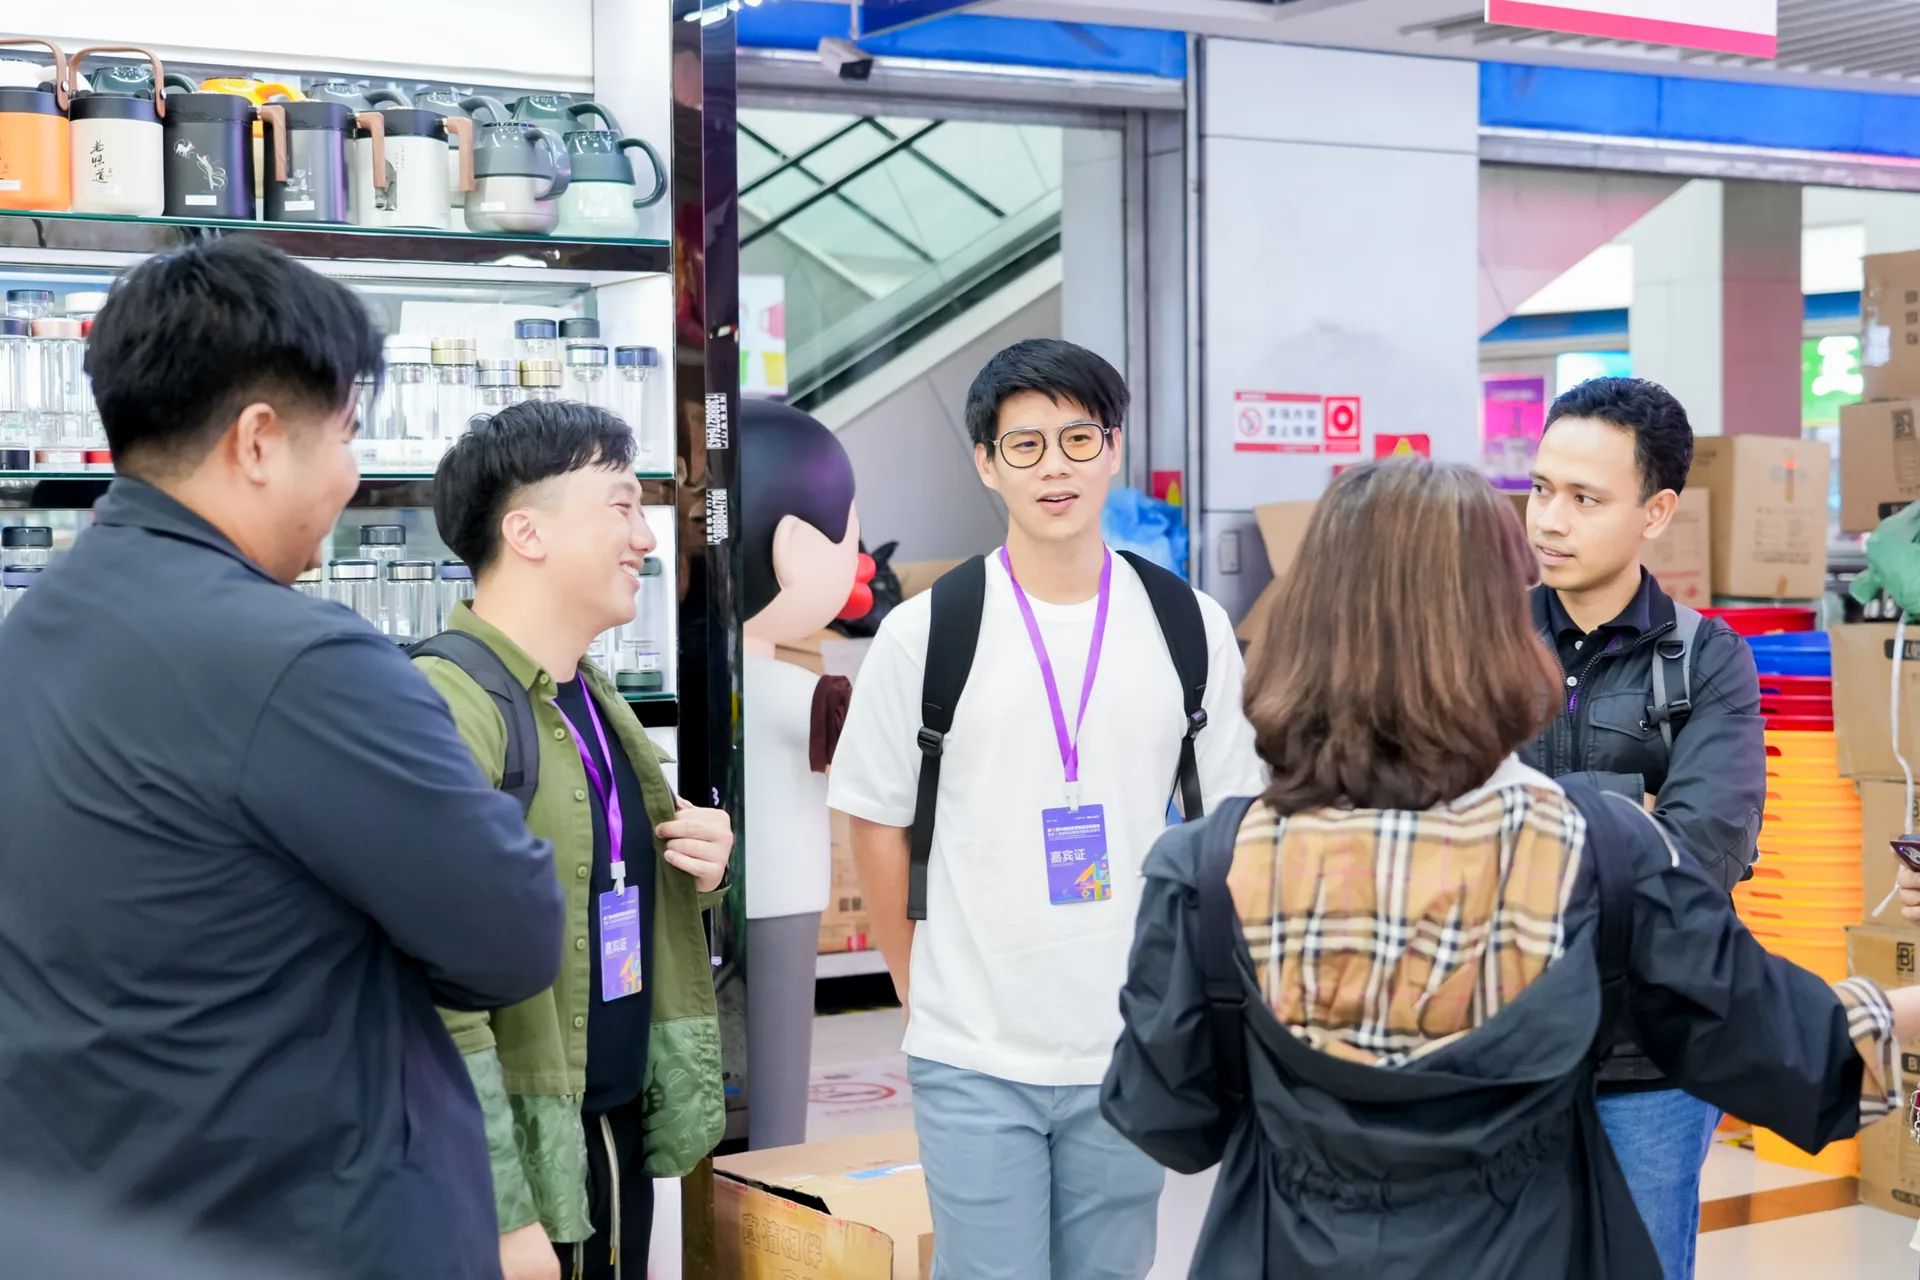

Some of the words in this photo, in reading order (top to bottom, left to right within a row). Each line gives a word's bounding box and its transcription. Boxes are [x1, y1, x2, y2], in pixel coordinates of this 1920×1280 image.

[90, 139, 108, 183] 老味道
[1050, 848, 1087, 863] 嘉宾证
